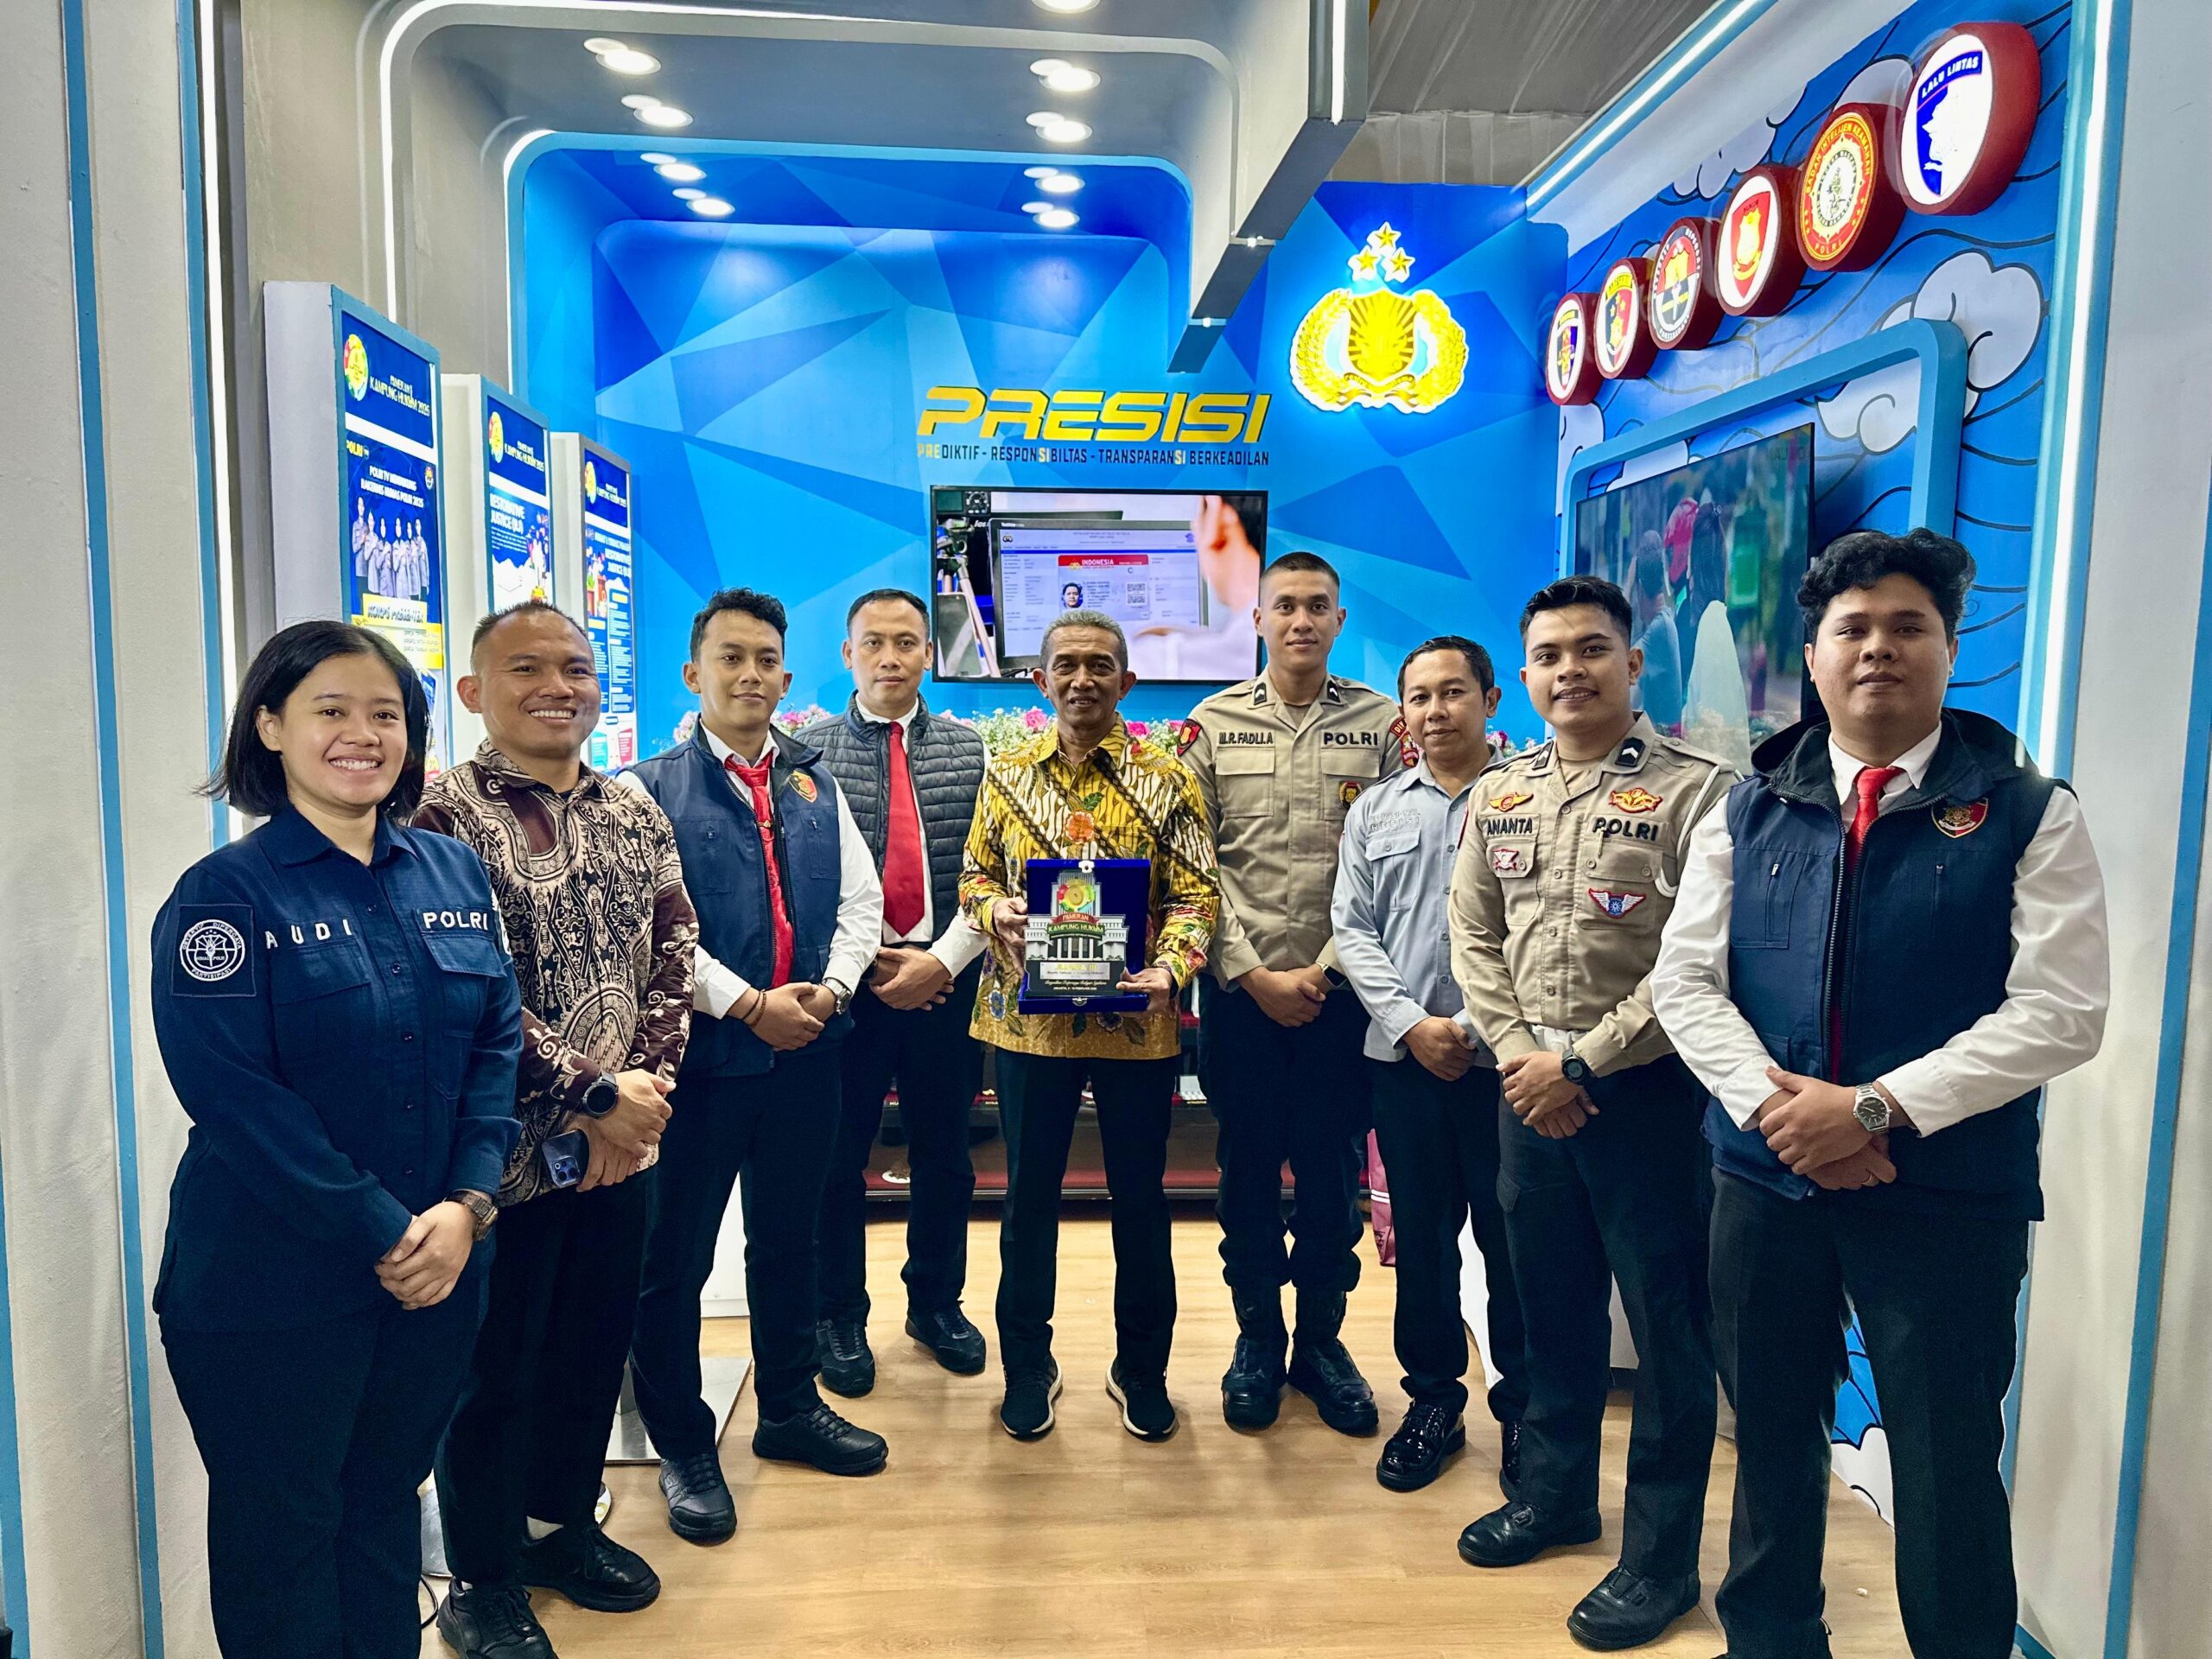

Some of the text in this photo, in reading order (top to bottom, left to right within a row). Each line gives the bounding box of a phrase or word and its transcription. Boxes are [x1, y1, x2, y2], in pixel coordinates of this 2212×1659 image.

[1922, 56, 1979, 99] LALU LINTAS
[1805, 153, 1821, 194] BADAN
[1821, 123, 1853, 151] INTELIJEN
[1853, 124, 1871, 175] KEAMANAN
[1815, 239, 1841, 254] POLRI
[370, 376, 397, 401] KAMPUNG
[917, 385, 1271, 443] PRESISI
[917, 442, 980, 461] PREDIKTIF
[991, 446, 1087, 463] RESPONSIBILTAS
[1098, 448, 1186, 465] TRANSPARANSI
[1190, 450, 1269, 466] BERKEADILAN
[1323, 732, 1378, 747] POLRI
[1487, 817, 1533, 836] ANANTA
[1592, 817, 1659, 842] POLRI
[423, 911, 489, 931] POLRI
[1048, 924, 1103, 933] KAMPUNG HUKUM
[213, 922, 242, 950] DIPERCAYA
